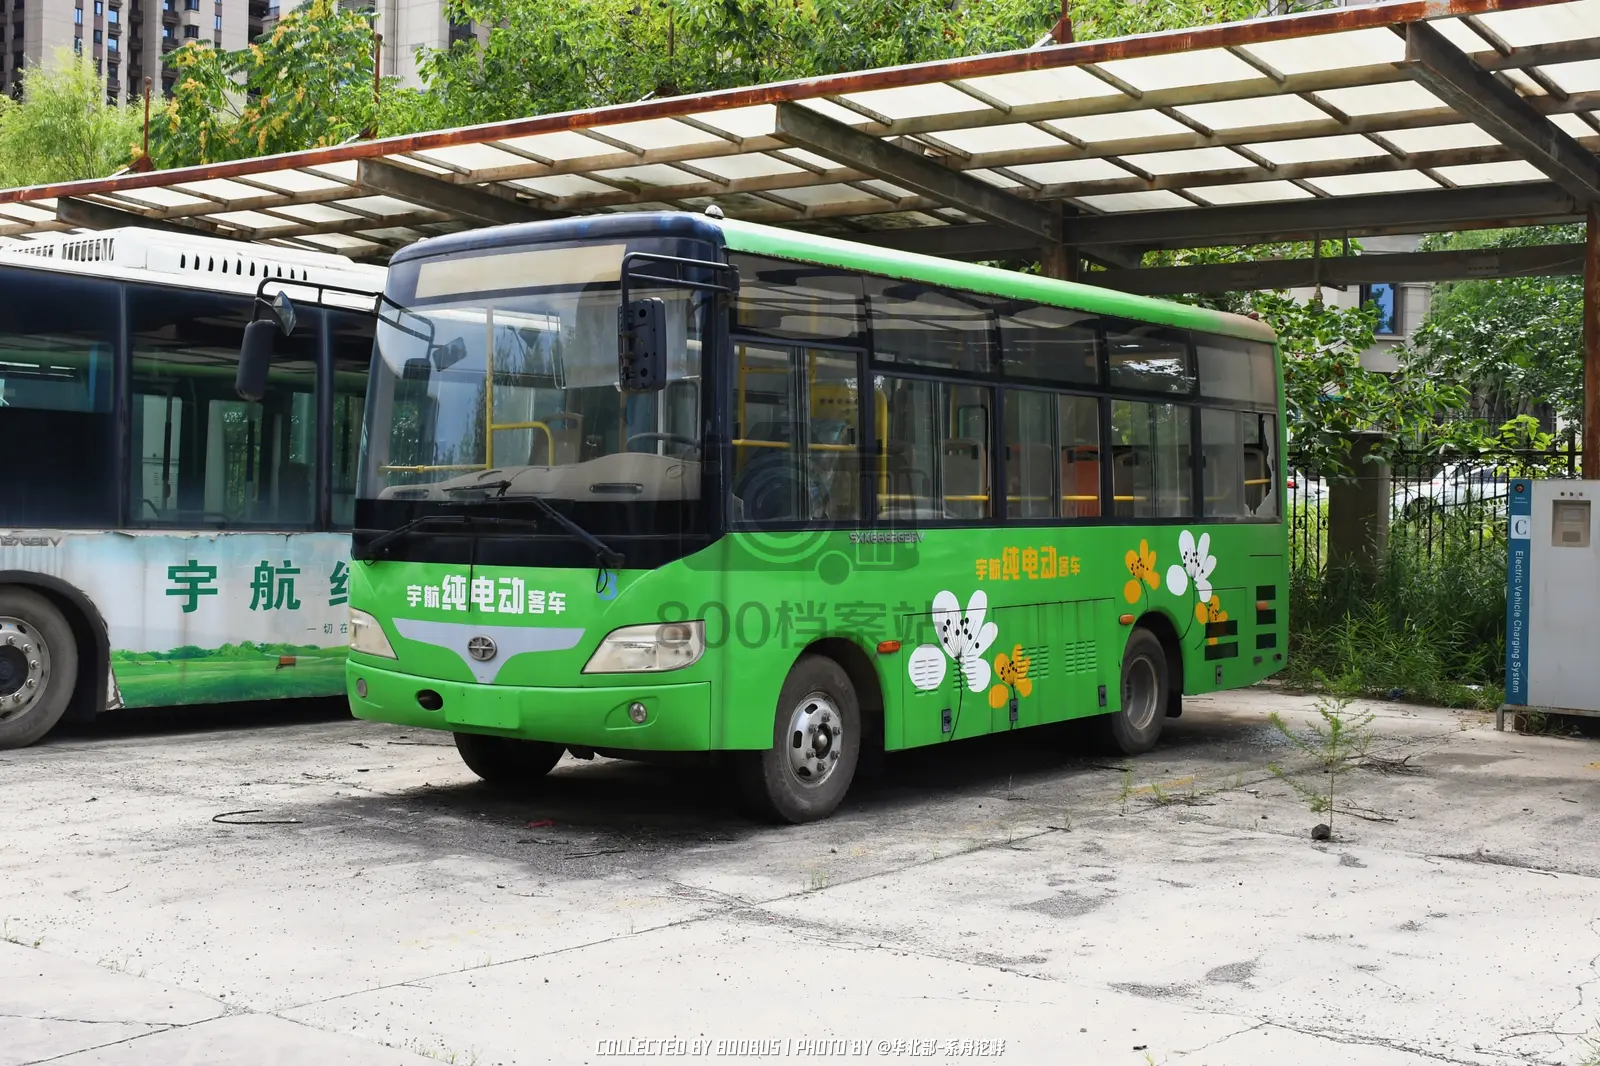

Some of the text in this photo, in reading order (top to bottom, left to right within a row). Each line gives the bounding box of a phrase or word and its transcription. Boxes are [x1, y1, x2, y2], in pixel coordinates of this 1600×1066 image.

[1515, 518, 1528, 536] C
[975, 545, 1081, 581] 宇航纯电动客车
[406, 574, 566, 615] 宇航纯电动客车
[1511, 550, 1524, 693] Electric Vehicle Charging System
